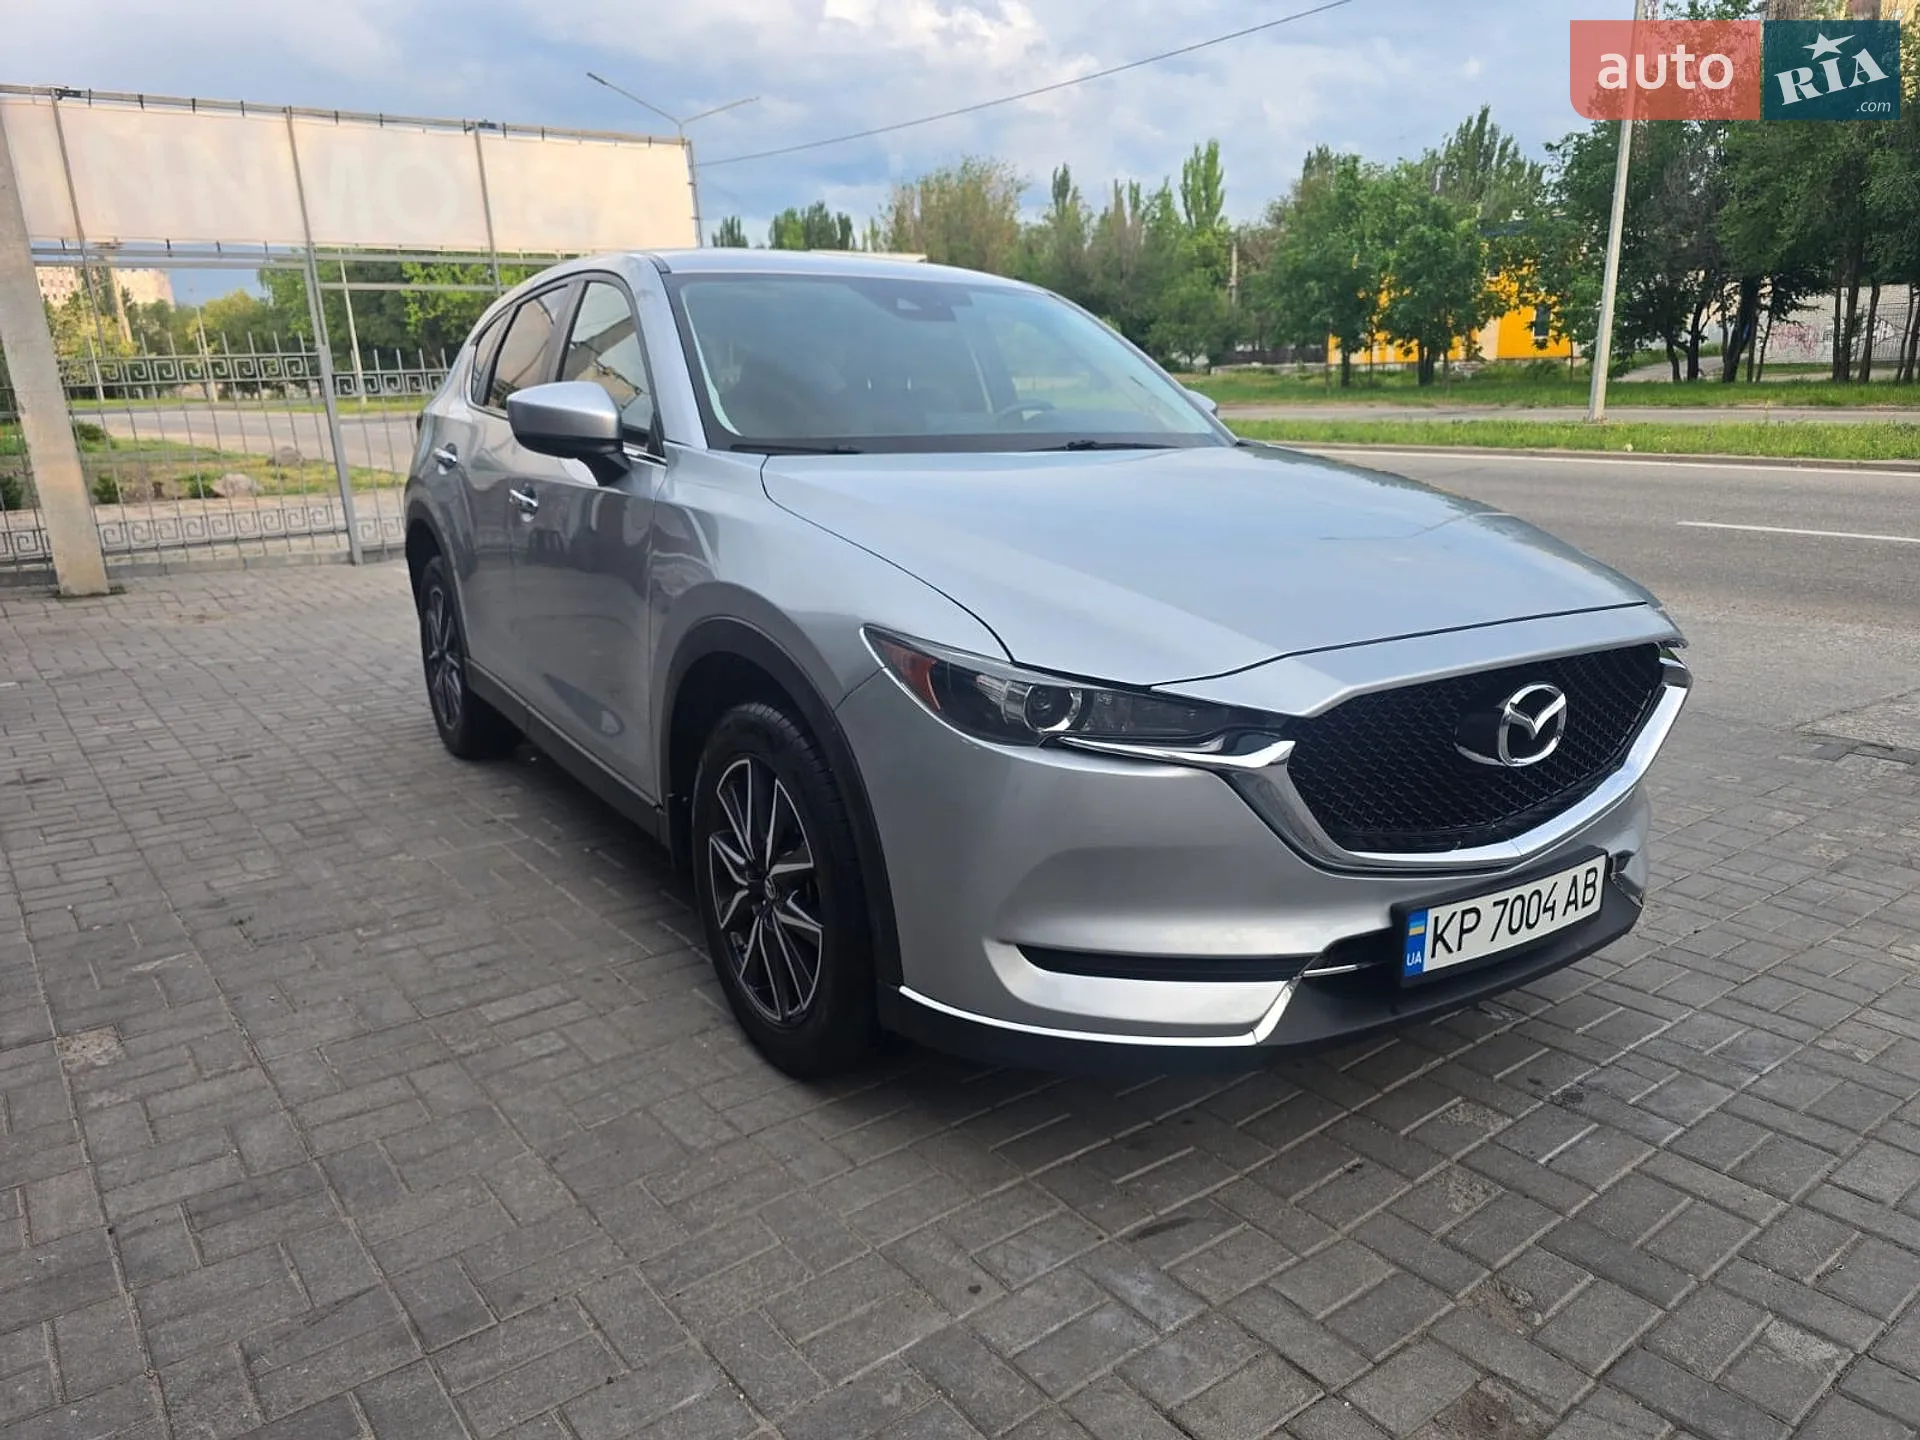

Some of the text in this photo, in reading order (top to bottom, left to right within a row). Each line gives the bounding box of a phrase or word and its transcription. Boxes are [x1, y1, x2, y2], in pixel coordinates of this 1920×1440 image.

[1430, 867, 1598, 959] KP 7004 AB
[1406, 952, 1422, 967] UA
